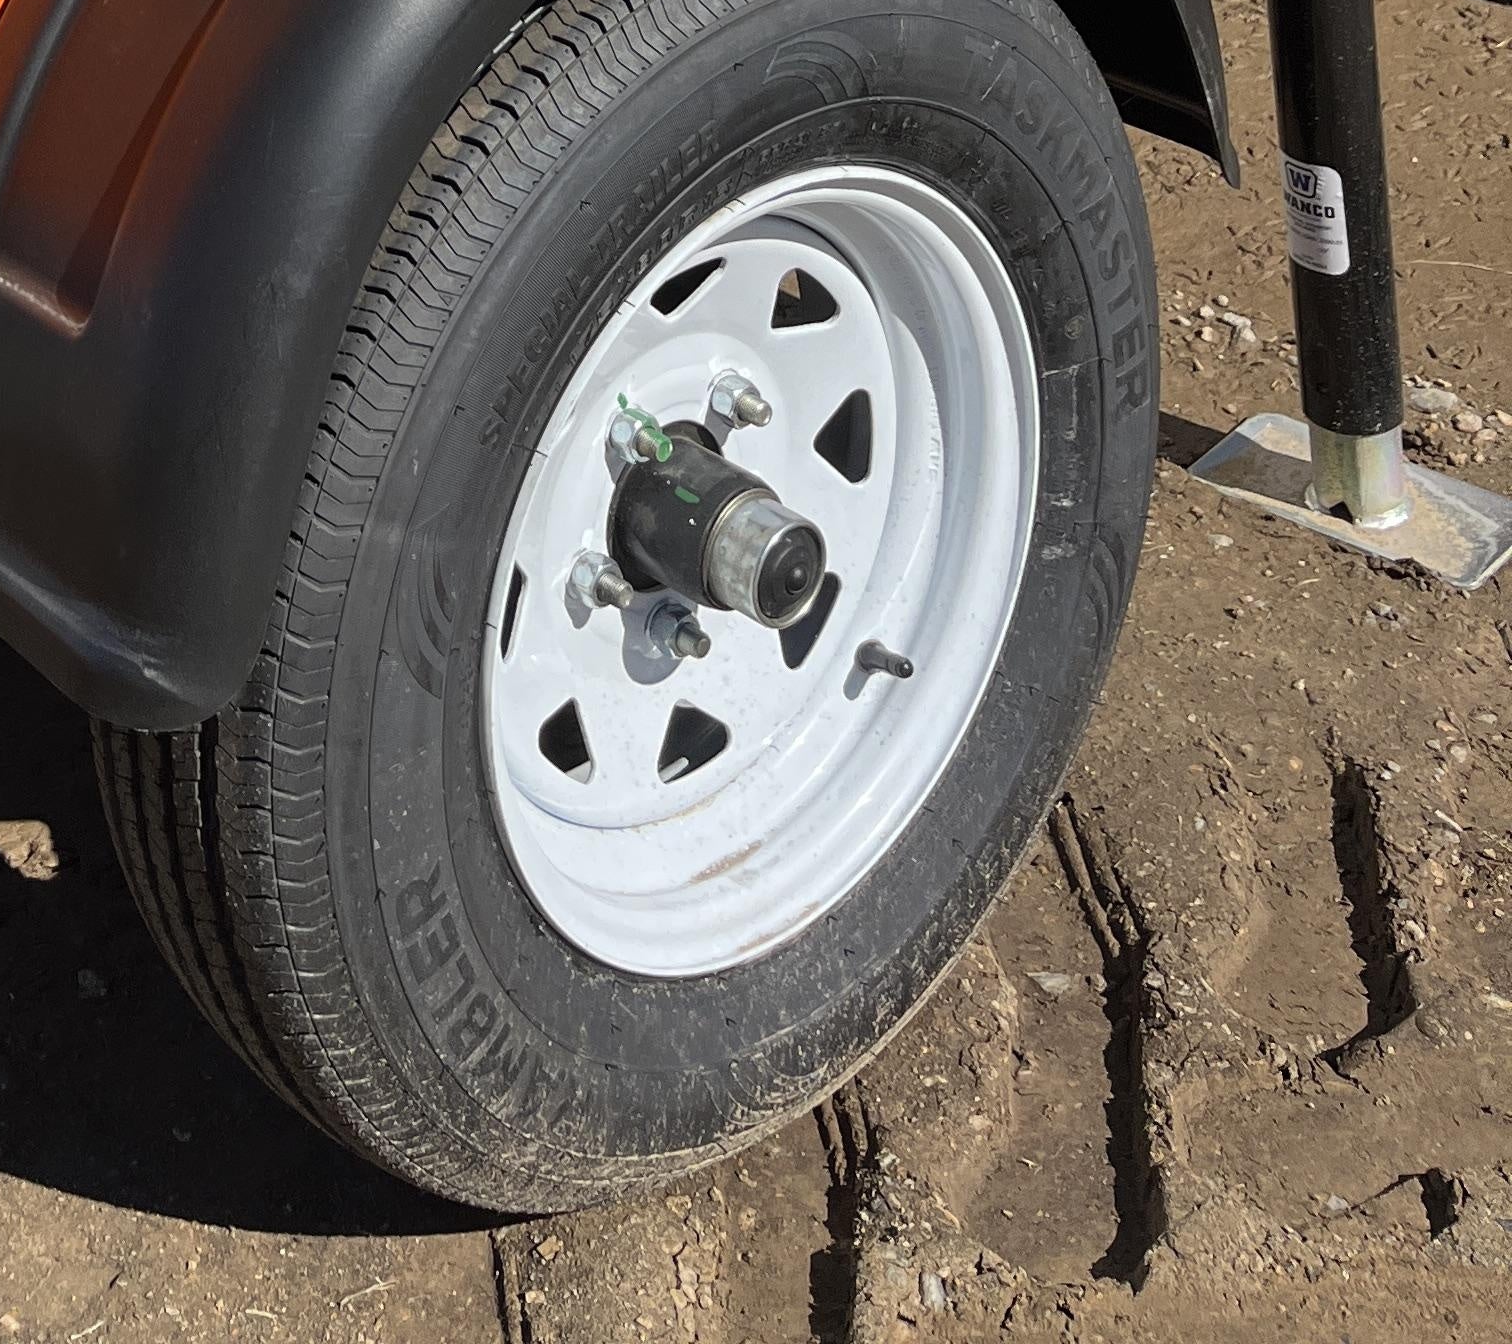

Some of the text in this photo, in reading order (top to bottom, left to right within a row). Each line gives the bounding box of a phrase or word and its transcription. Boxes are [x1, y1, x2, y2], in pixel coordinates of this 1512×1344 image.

[479, 268, 591, 446] SPECIAL
[589, 118, 721, 260] TRAILER
[962, 33, 1152, 417] TASKMASTER
